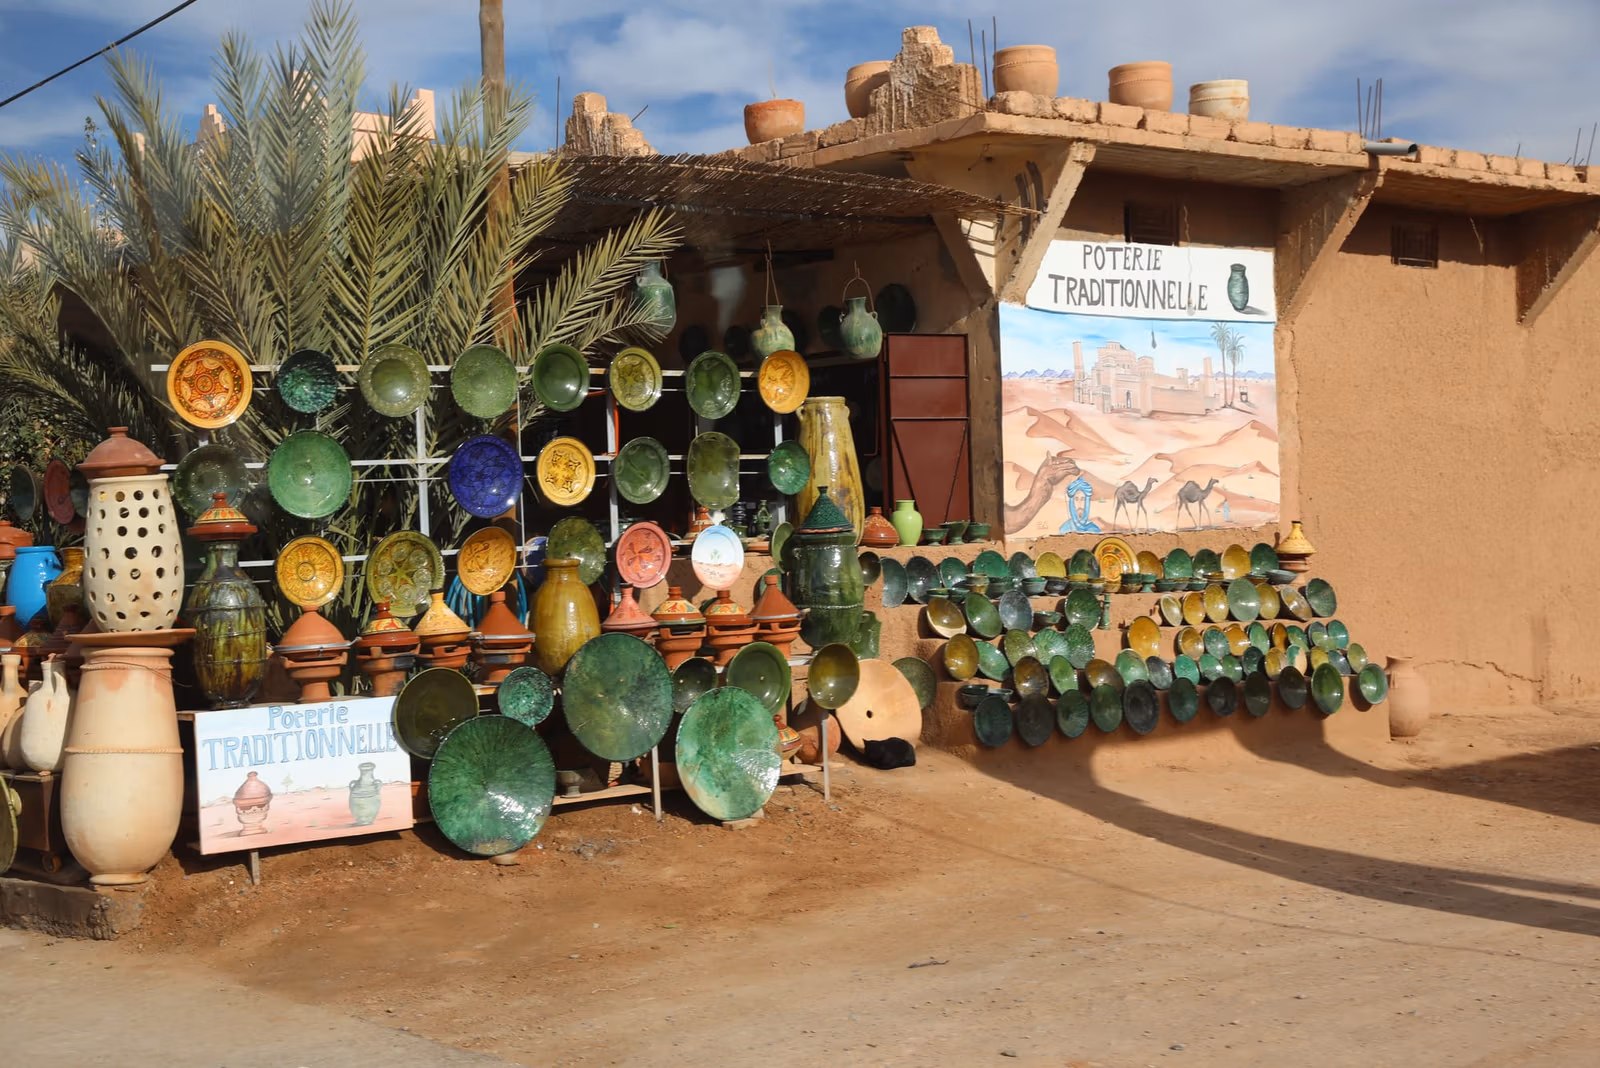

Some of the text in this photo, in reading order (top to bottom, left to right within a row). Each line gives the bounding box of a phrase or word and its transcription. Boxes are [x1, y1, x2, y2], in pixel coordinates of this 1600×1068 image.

[1083, 244, 1162, 271] POTERIE
[1048, 274, 1208, 311] TRADITIONNELLE
[202, 722, 397, 770] TRADITIONNELLE
